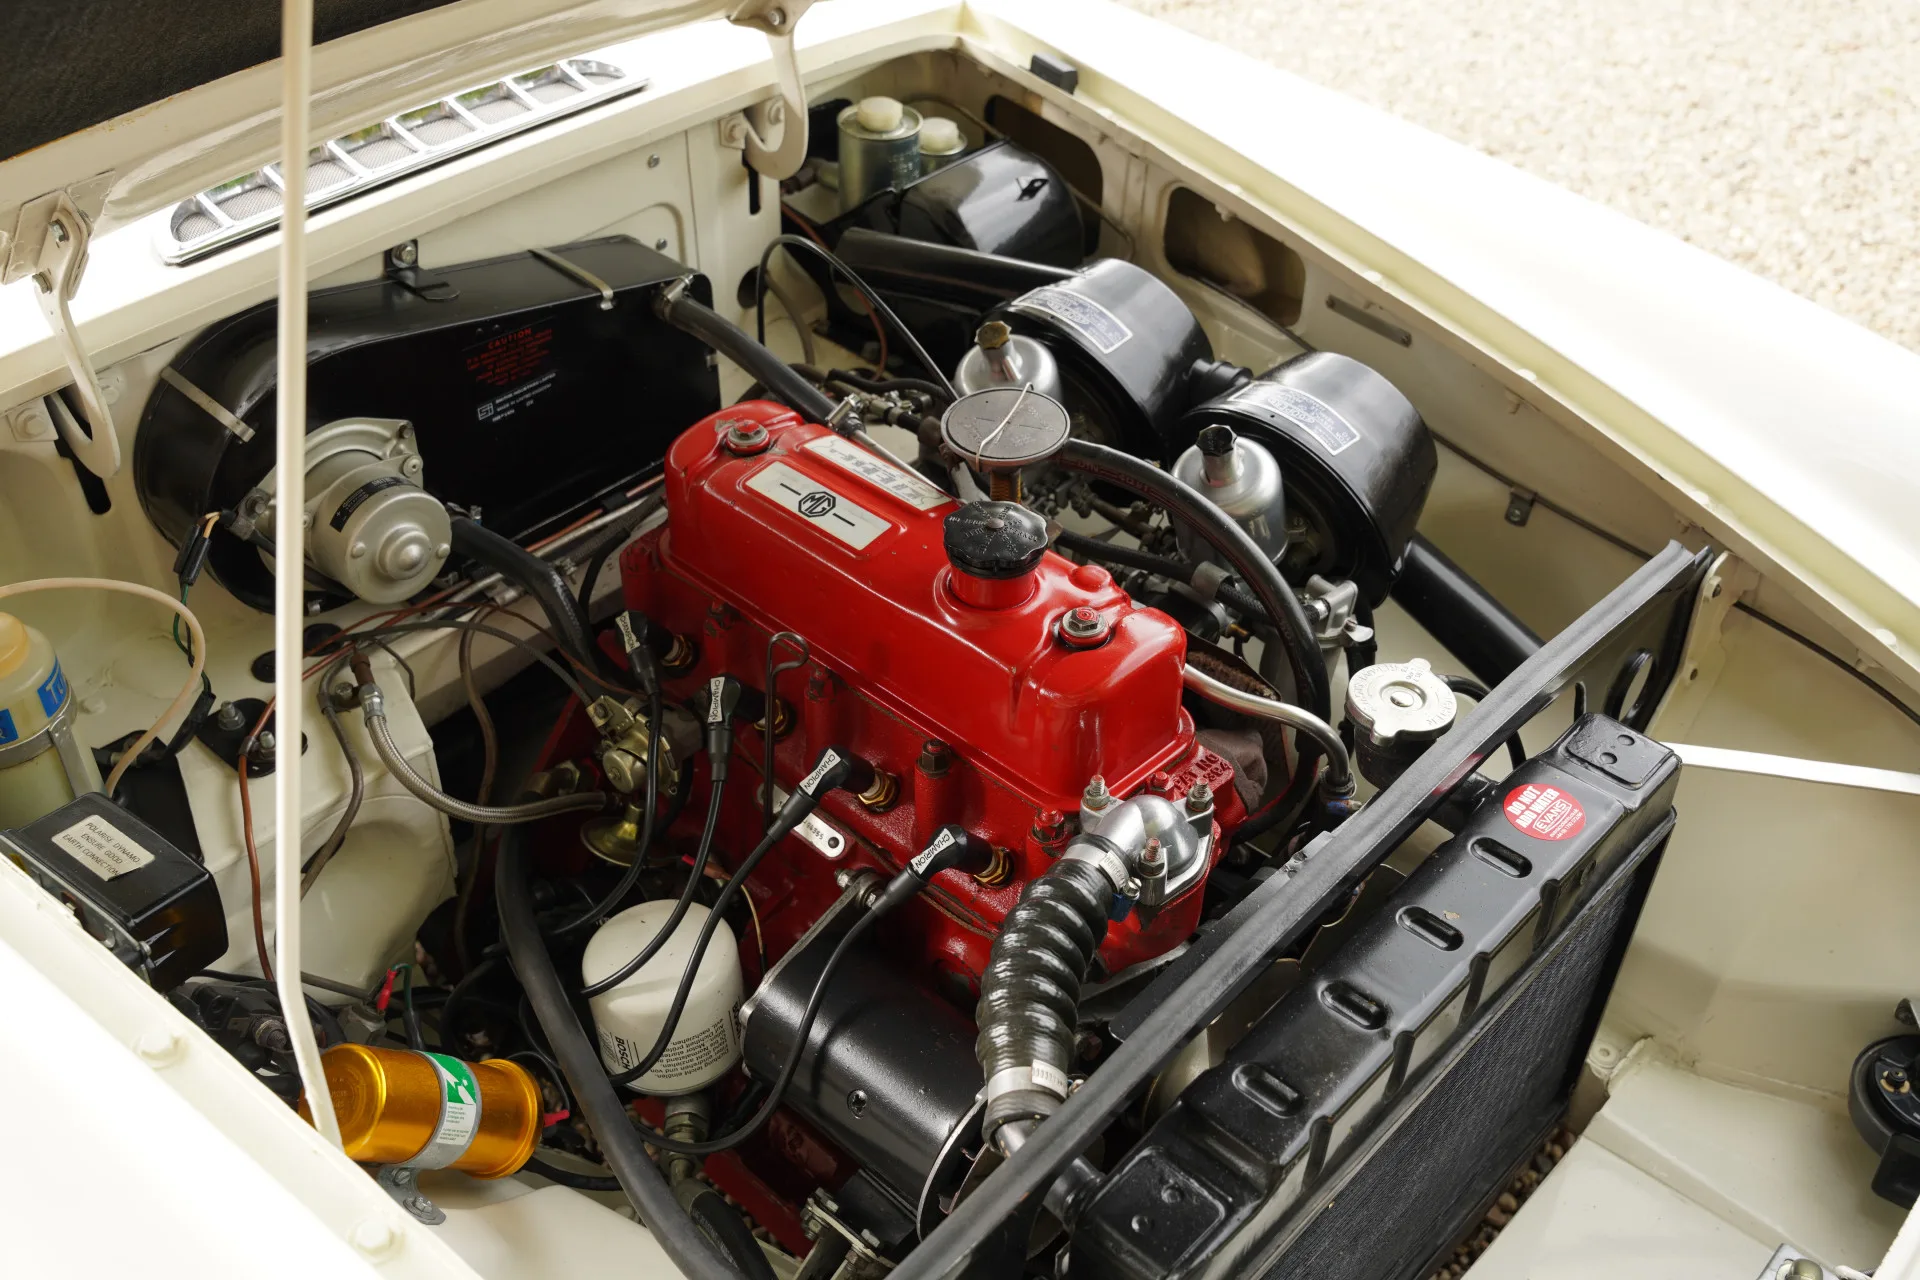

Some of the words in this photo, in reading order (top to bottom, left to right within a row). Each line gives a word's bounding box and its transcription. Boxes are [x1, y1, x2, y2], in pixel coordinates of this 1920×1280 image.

[488, 328, 532, 349] CAUTION
[801, 493, 832, 516] MG
[620, 615, 635, 649] CHAMPION
[709, 680, 720, 720] CHAMPION
[804, 754, 836, 790] CHAMPION
[1507, 801, 1526, 816] DO
[1517, 785, 1540, 805] NOT
[1515, 810, 1538, 828] ADD
[1529, 788, 1560, 813] WATER
[1537, 801, 1566, 829] EVANS
[62, 834, 82, 850] EARTH
[82, 847, 120, 876] CONNECTION
[81, 833, 105, 851] ENSURE
[104, 850, 122, 864] GOOD
[86, 822, 113, 844] POLARISE
[113, 843, 140, 863] DYNAMO
[915, 834, 950, 868] CHAMPION
[615, 1036, 631, 1070] BOSCH
